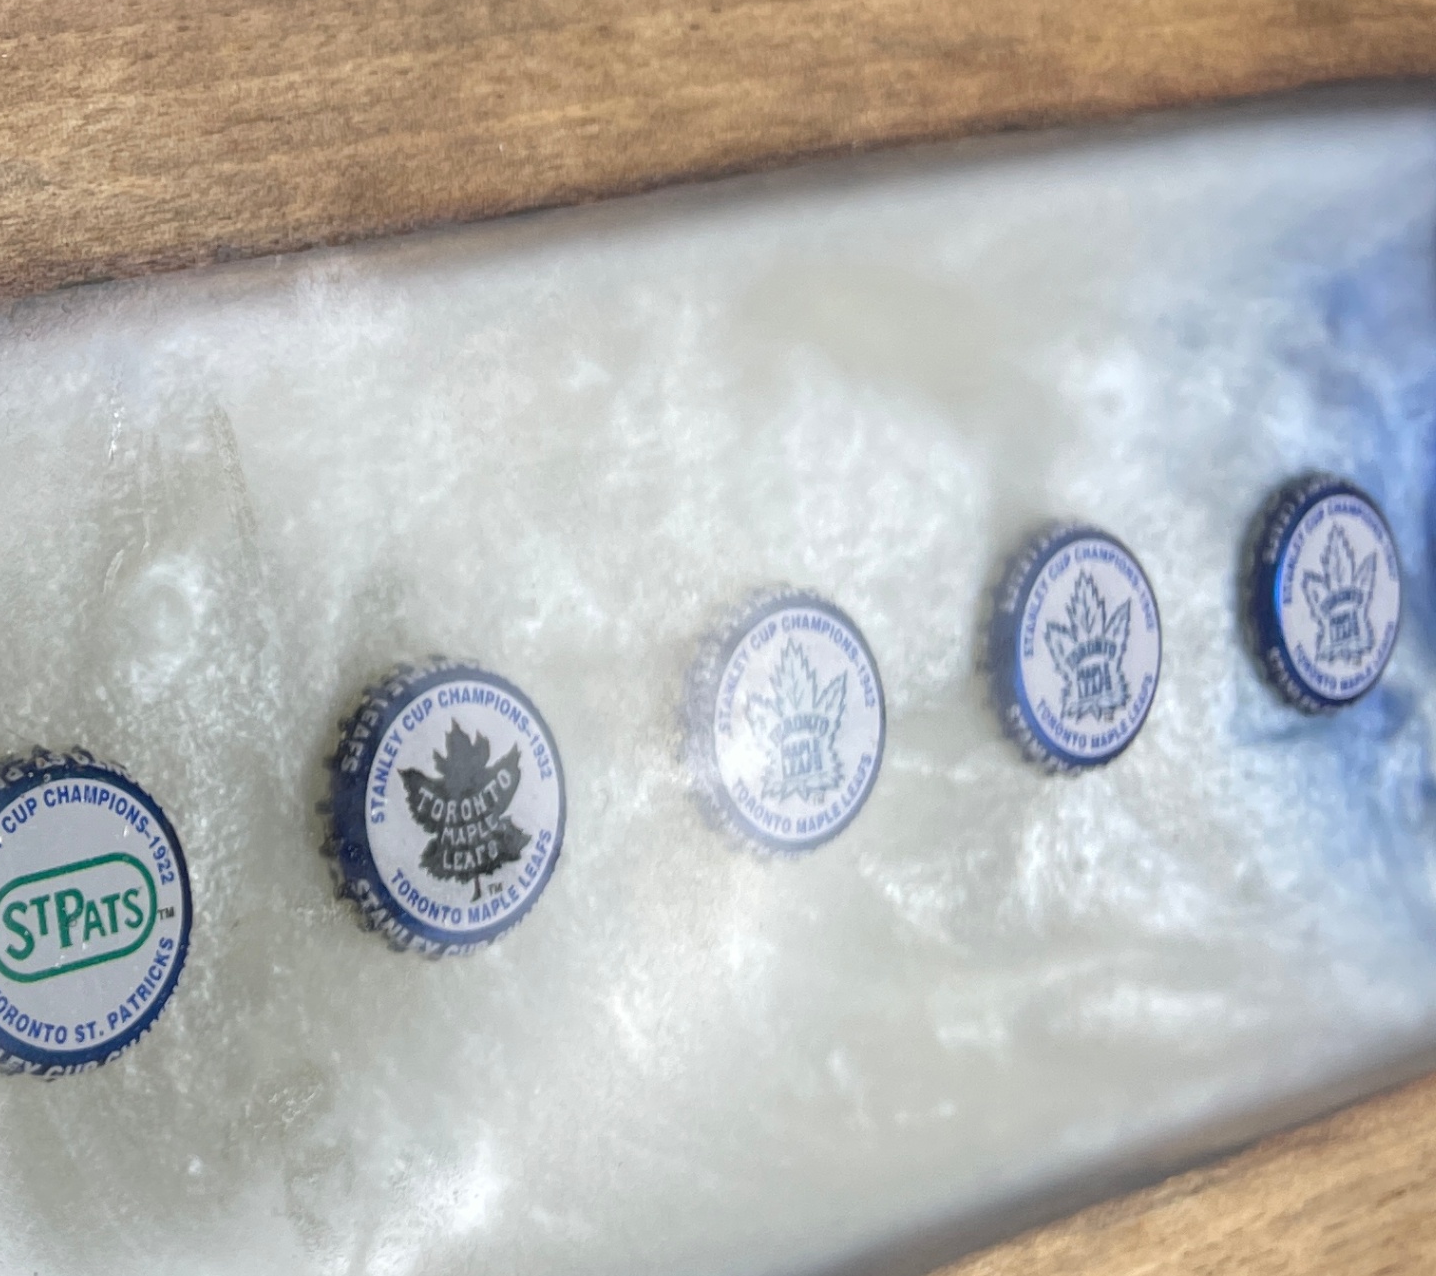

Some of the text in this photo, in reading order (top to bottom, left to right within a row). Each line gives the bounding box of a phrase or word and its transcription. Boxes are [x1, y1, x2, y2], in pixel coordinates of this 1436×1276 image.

[749, 622, 778, 649] CUP
[370, 686, 553, 824] STANLEY CUP CHAMPIONS-1932
[417, 768, 512, 823] TORONTO
[732, 776, 792, 834] TORONTO
[795, 800, 843, 834] MAPLE
[1, 797, 39, 834] CUP
[42, 783, 175, 885] CHAMPIONS-1922
[440, 812, 500, 845] MAPLE
[390, 829, 552, 924] TORONTO MAPLE LEAFS
[157, 907, 175, 921] TM
[74, 1021, 106, 1045] ST.
[107, 936, 175, 1031] PATRICKS
